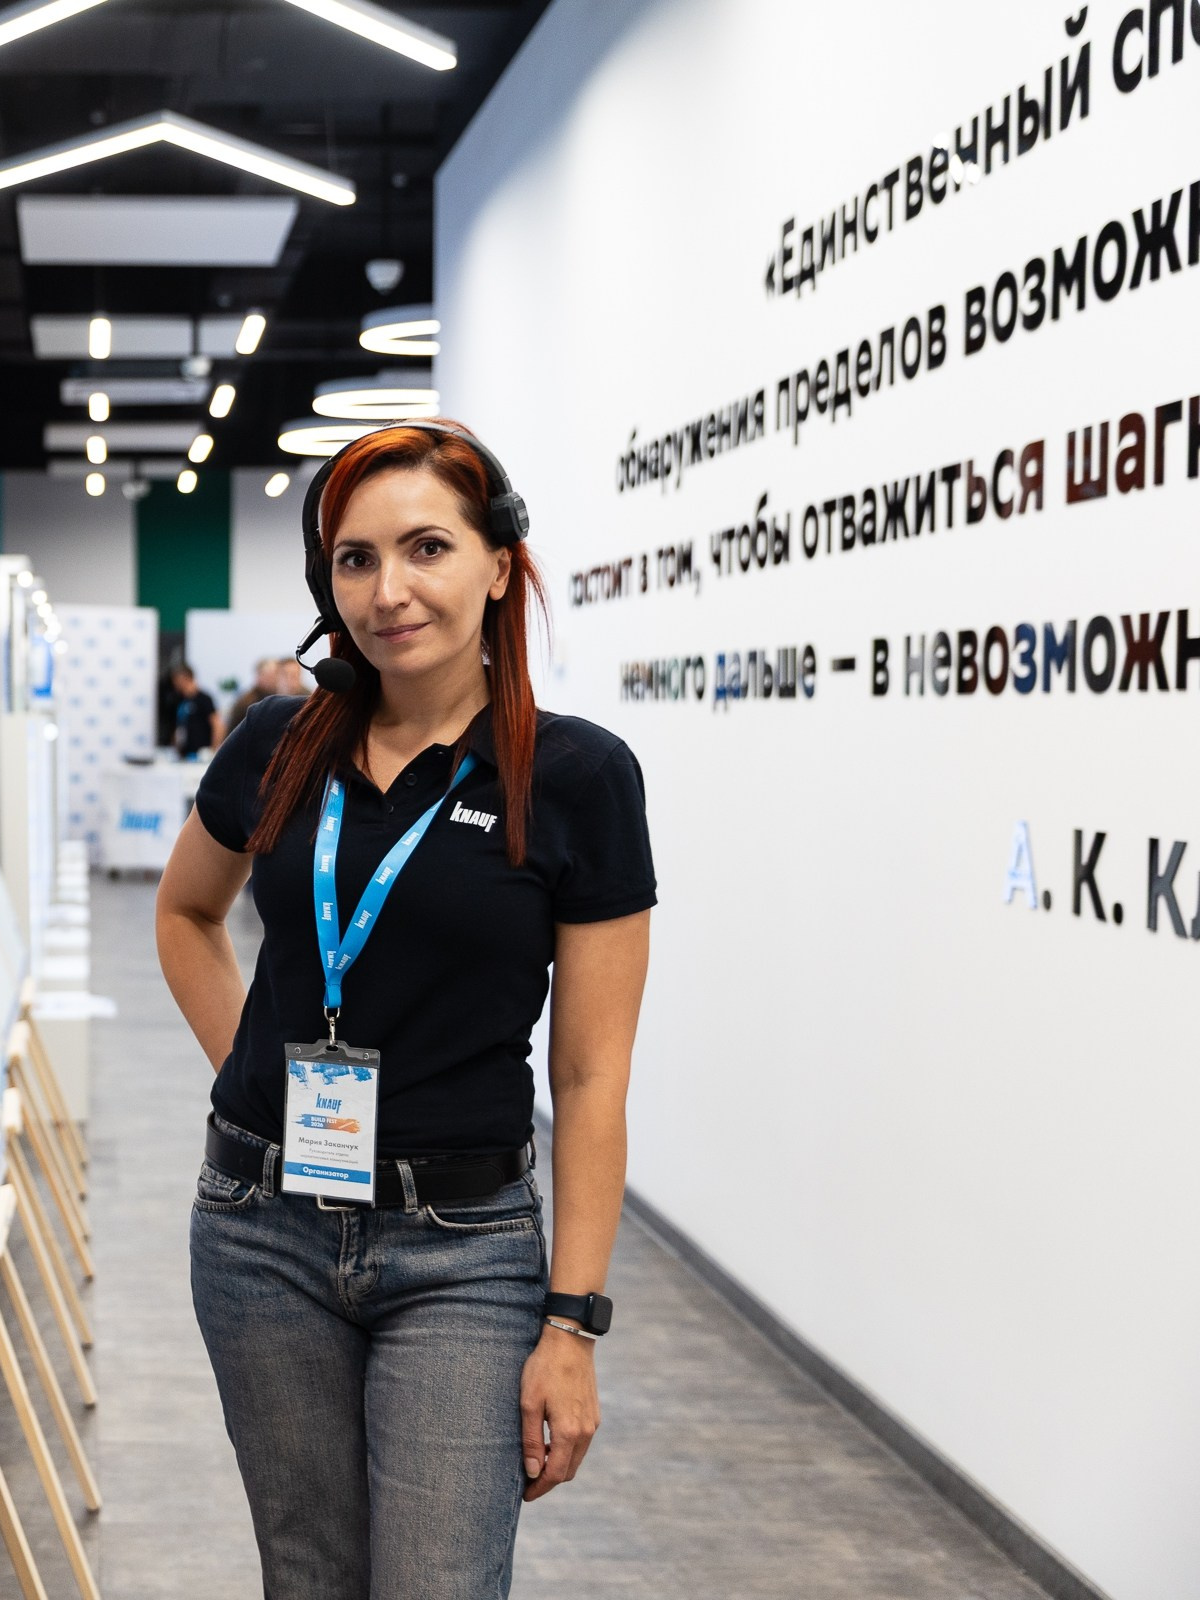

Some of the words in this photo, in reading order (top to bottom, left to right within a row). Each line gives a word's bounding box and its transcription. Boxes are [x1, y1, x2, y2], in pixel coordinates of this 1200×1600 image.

[1112, 0, 1200, 94] сп
[616, 388, 765, 494] обнаружения
[776, 302, 947, 446] пределов
[640, 553, 650, 595] в
[657, 540, 702, 597] том,
[710, 490, 791, 575] чтобы
[802, 437, 1046, 560] отважиться
[620, 655, 705, 702] немного
[713, 644, 817, 713] дальше
[871, 637, 890, 697] в
[449, 801, 498, 833] KNAUF
[1004, 818, 1053, 912] А.
[1071, 828, 1124, 927] К.
[1146, 837, 1200, 942] К
[315, 1092, 343, 1114] KNAUF
[298, 1136, 323, 1147] Мария
[302, 1166, 350, 1179] Организатор
